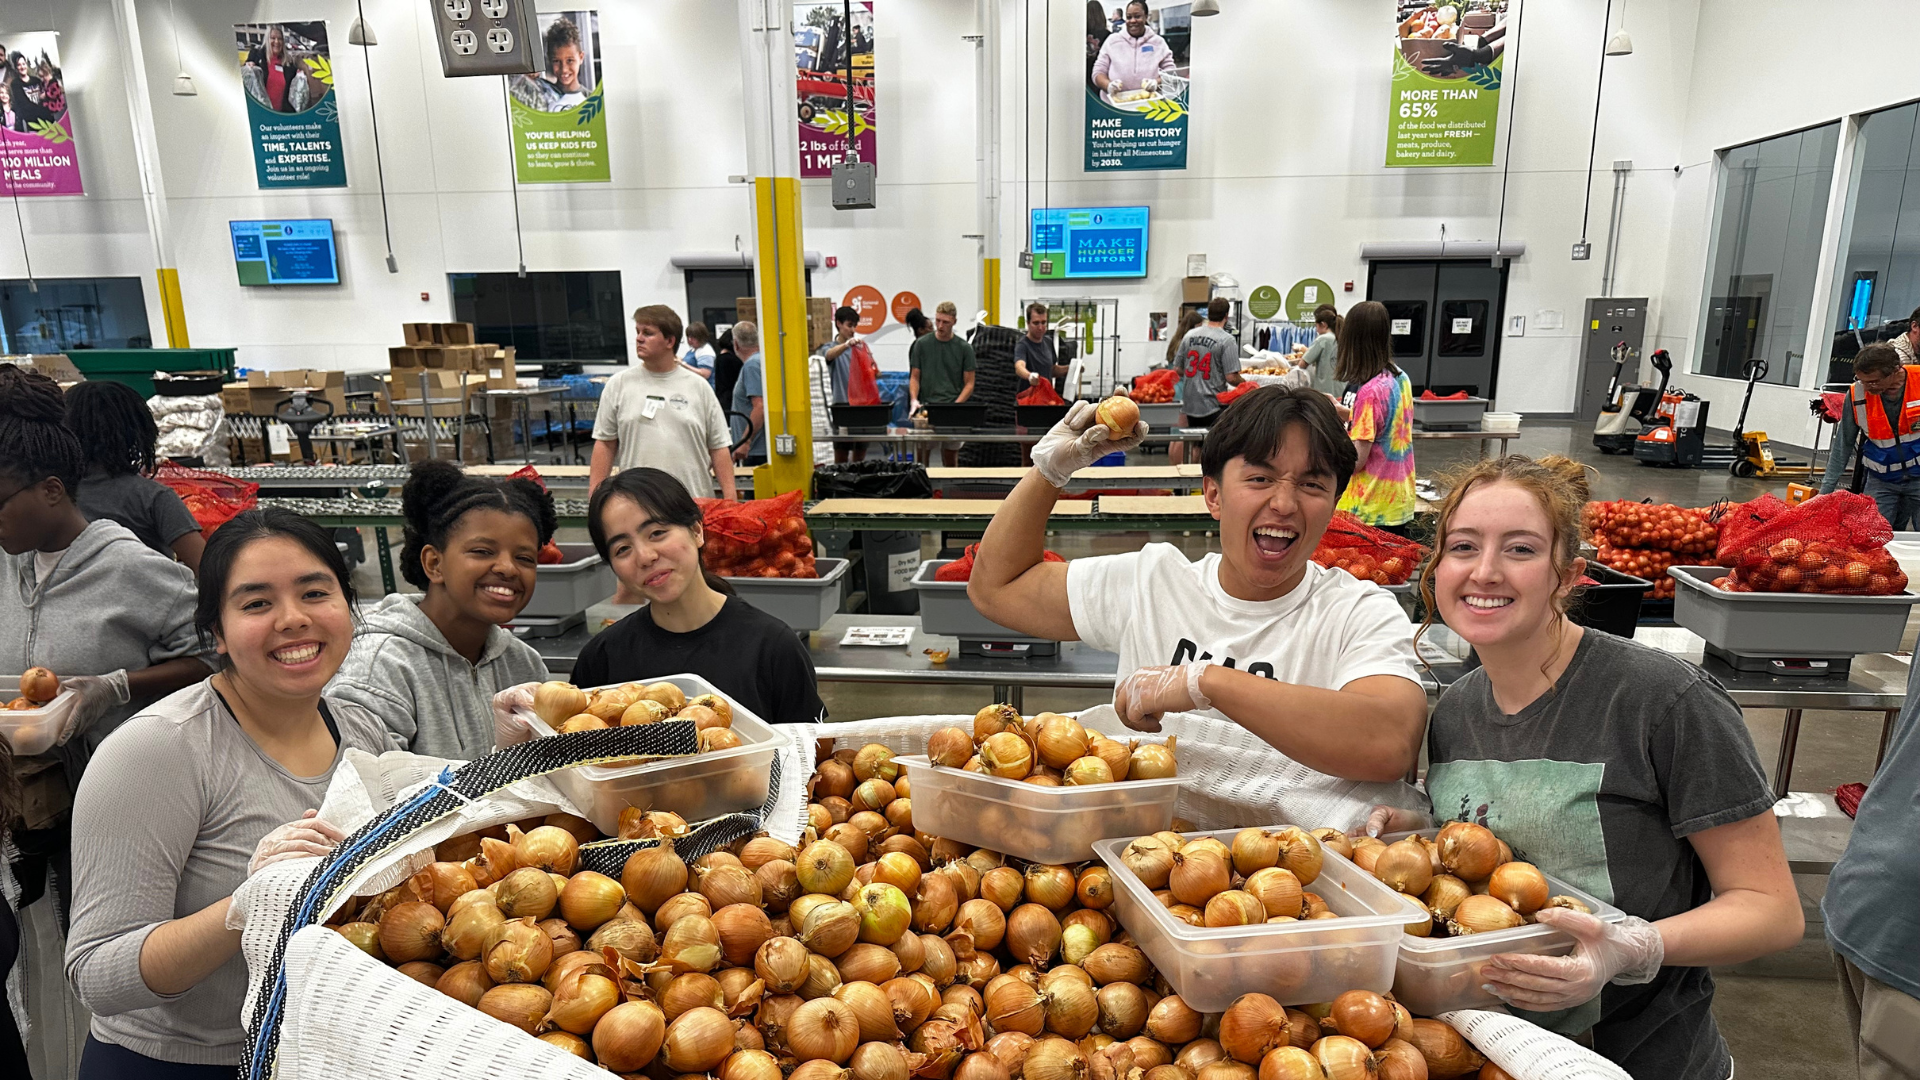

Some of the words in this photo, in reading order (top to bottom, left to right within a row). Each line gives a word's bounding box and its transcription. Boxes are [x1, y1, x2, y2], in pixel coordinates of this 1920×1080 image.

[1401, 90, 1438, 100] MORE
[1442, 89, 1478, 100] THAN
[1400, 102, 1438, 118] 65%
[273, 123, 304, 132] volunteers
[1092, 118, 1122, 128] MAKE
[1398, 122, 1406, 130] of
[270, 133, 291, 141] impact
[525, 131, 554, 140] YOU'RE
[556, 130, 591, 139] HELPING
[1092, 129, 1135, 138] HUNGER
[1137, 128, 1182, 137] HISTORY
[1398, 131, 1410, 139] last
[1412, 132, 1428, 140] year
[262, 143, 288, 152] TIME,
[289, 141, 332, 151] TALENTS
[538, 141, 559, 150] KEEP
[810, 141, 827, 151] lbs
[828, 140, 840, 150] of
[840, 140, 862, 150] fod
[1113, 140, 1137, 148] helping
[1158, 139, 1181, 147] hunger
[1421, 141, 1452, 149] produce,
[278, 153, 331, 163] EXPERTISE.
[1396, 150, 1420, 159] bakery
[1436, 150, 1457, 158] dairy.
[1, 157, 21, 168] 100
[24, 156, 71, 167] MILLION
[804, 155, 812, 169] 1
[1092, 159, 1100, 168] by
[4, 169, 42, 180] MEALS
[1078, 239, 1135, 248] MAKE
[1189, 336, 1217, 349] PUCKETT
[1185, 350, 1212, 380] 34
